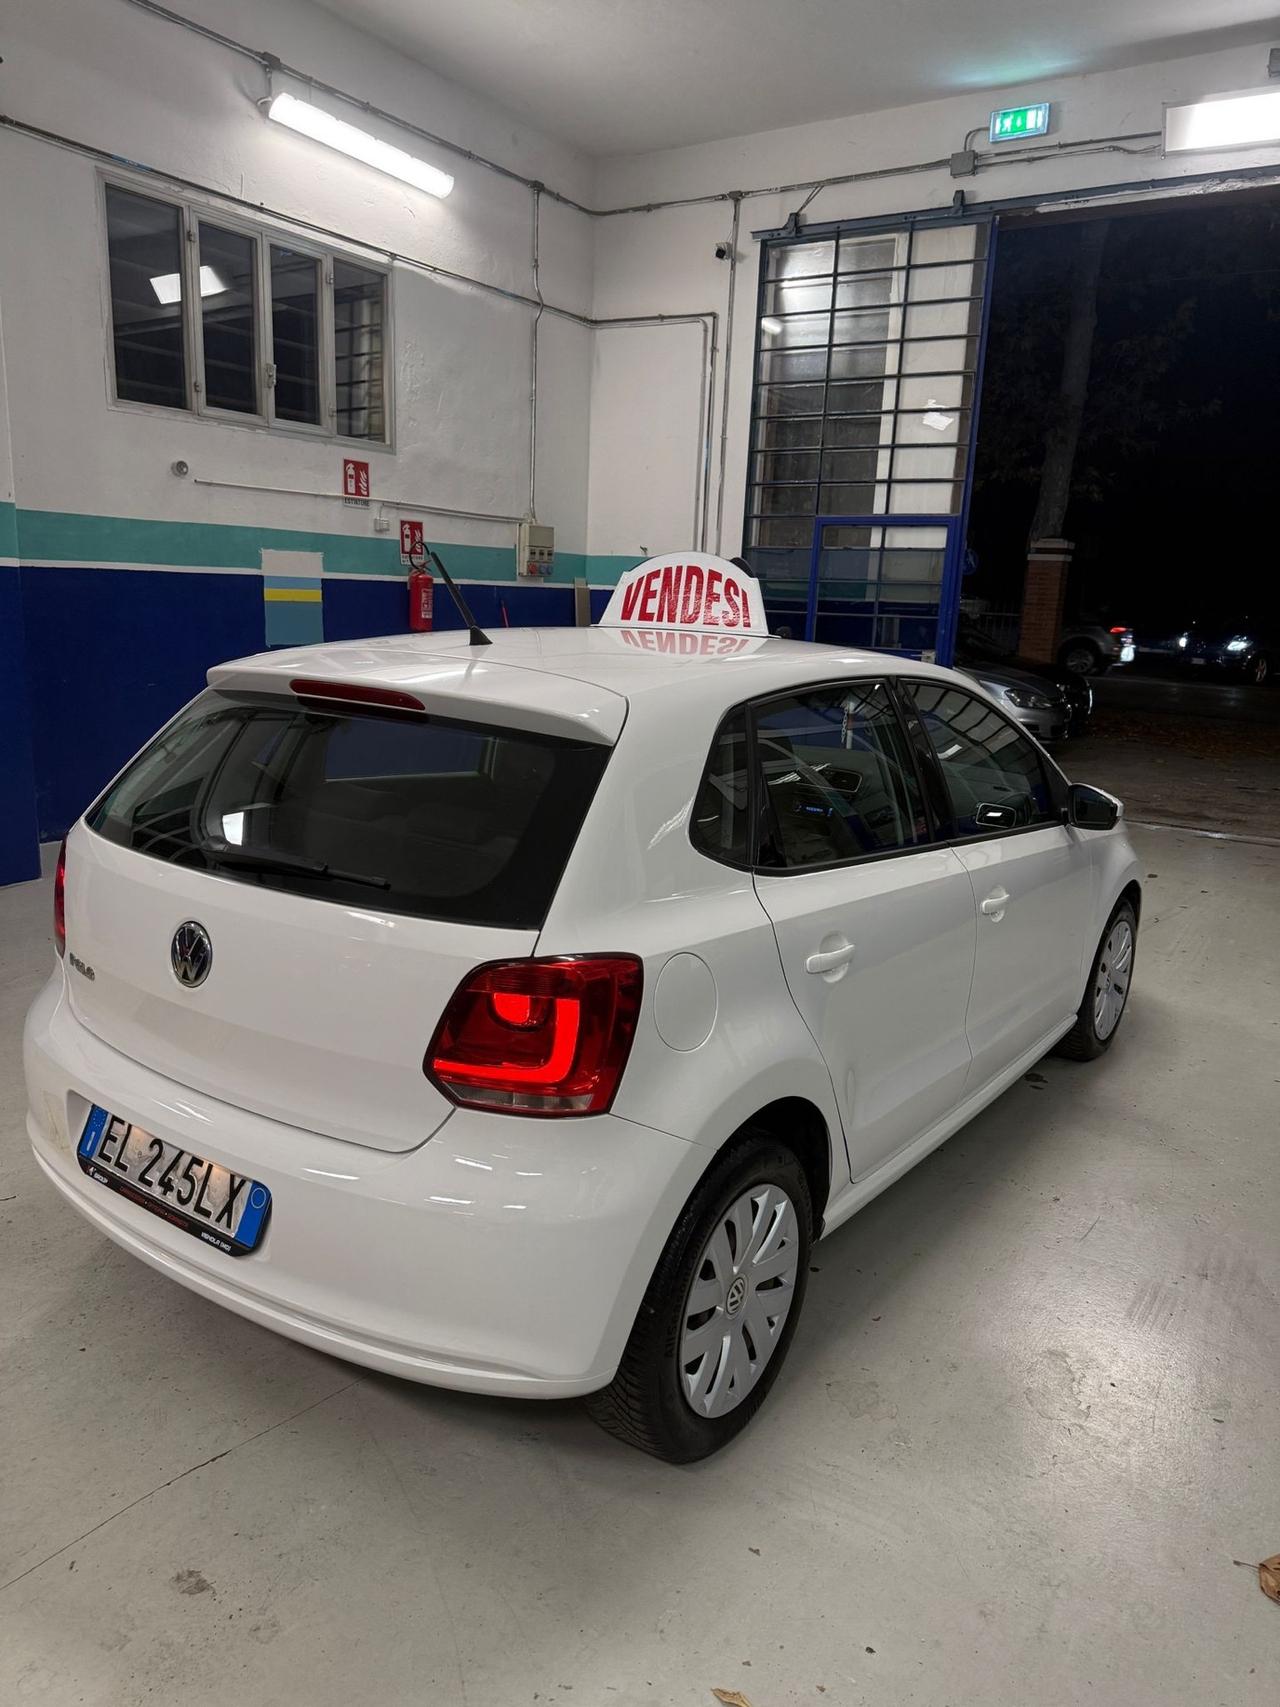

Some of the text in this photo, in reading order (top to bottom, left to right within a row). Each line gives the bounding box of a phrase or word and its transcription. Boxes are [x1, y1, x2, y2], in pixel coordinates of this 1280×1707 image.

[620, 565, 752, 628] VENDESI
[98, 1114, 133, 1172] EL
[138, 1138, 247, 1229] 245LX
